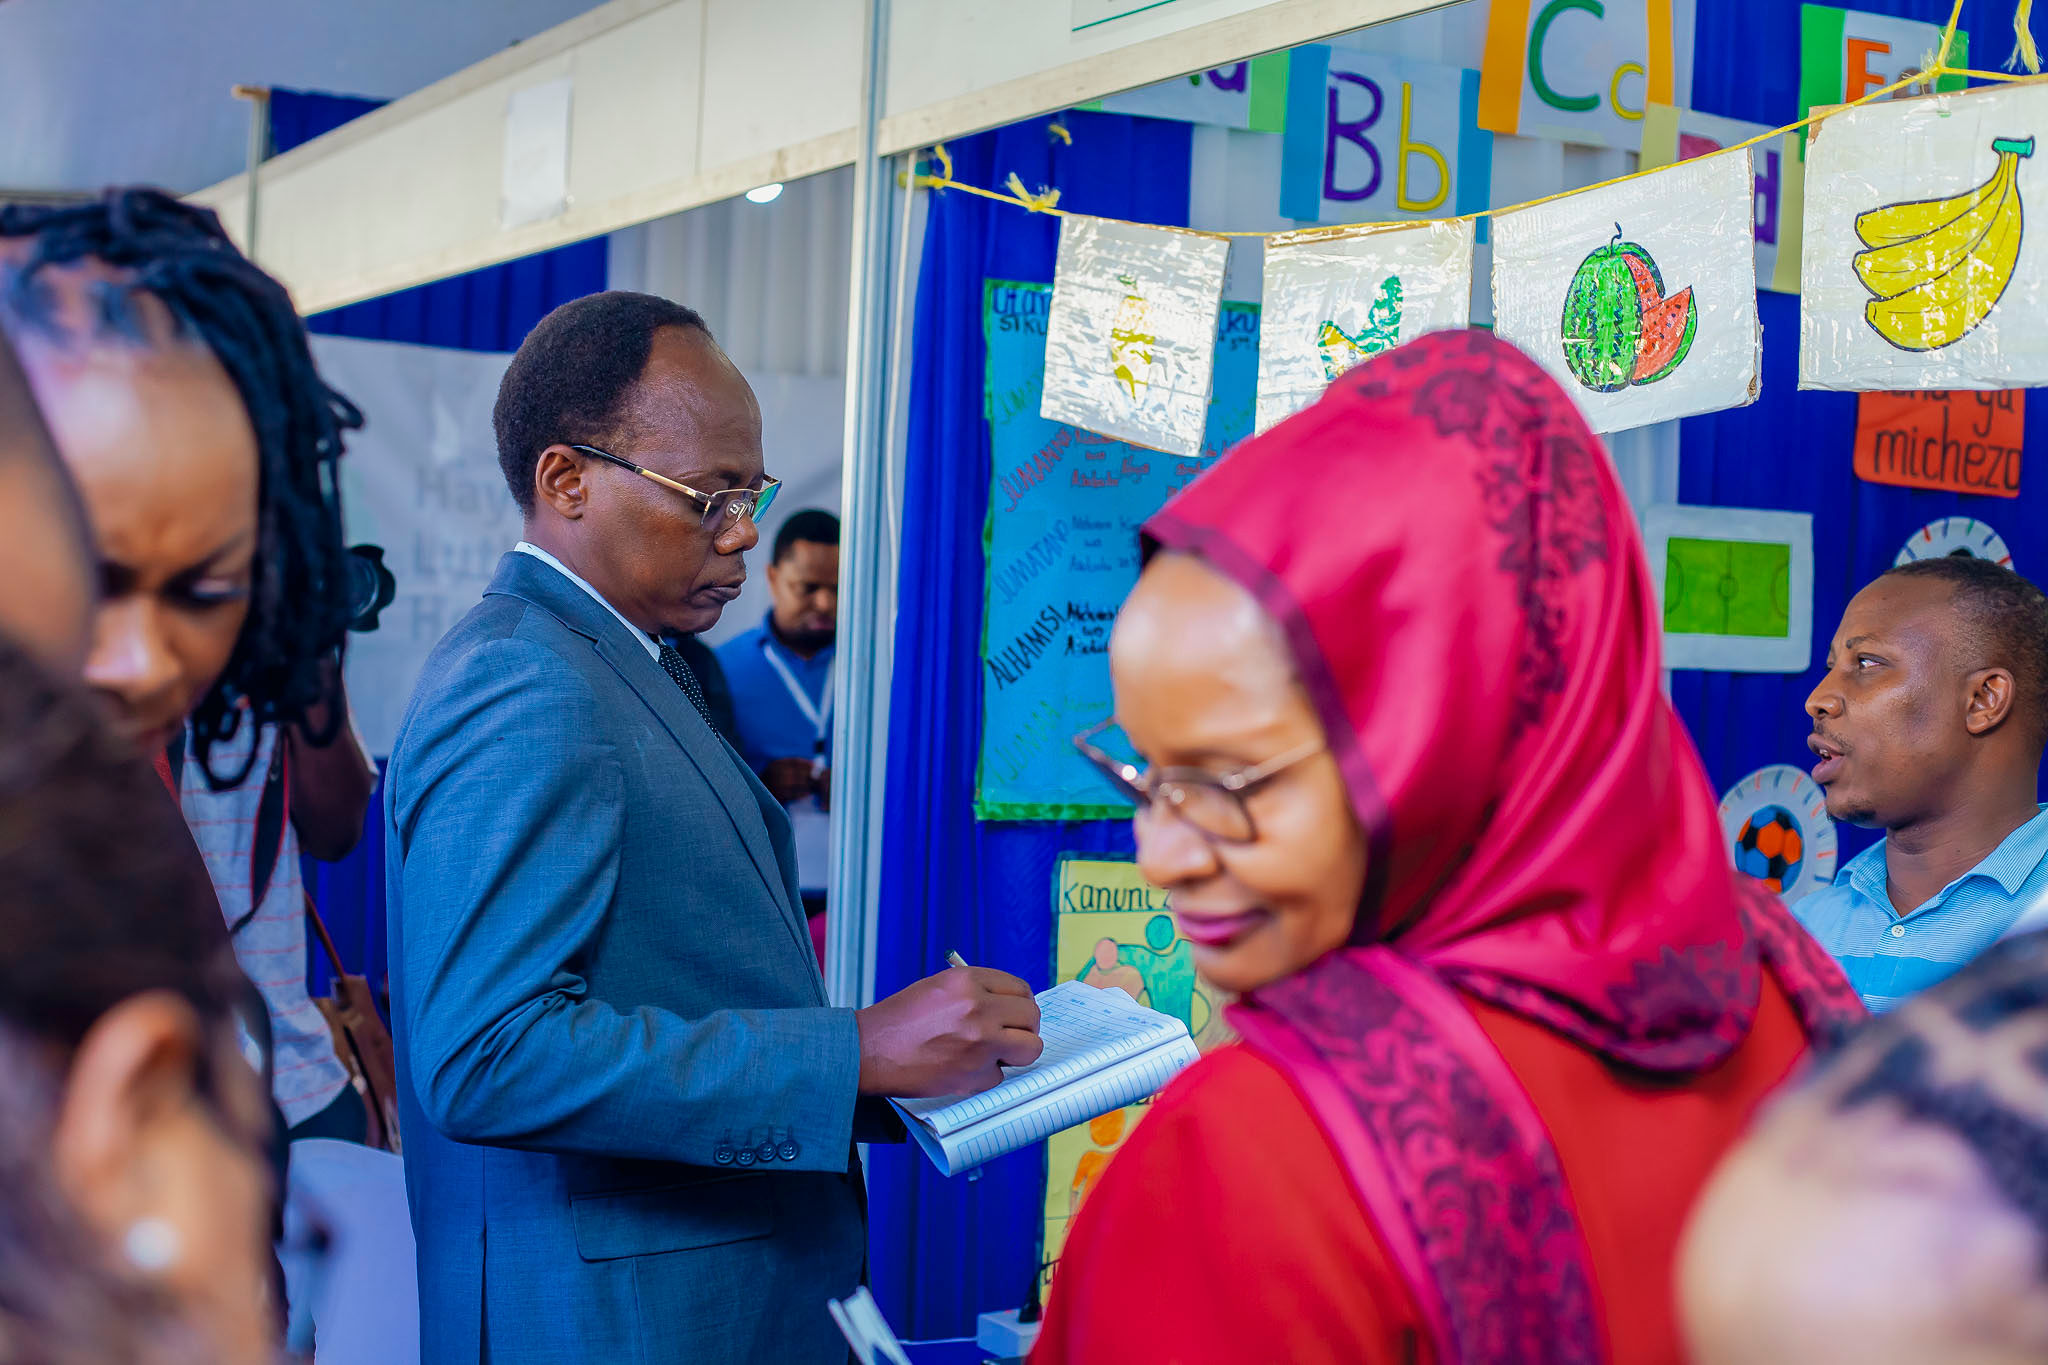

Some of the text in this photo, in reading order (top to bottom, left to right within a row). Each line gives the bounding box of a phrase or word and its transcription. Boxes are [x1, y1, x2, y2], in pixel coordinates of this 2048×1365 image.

[1874, 405, 2023, 491] michezo
[987, 604, 1067, 690] ALHAMISI
[1064, 881, 1153, 912] Kanuni
